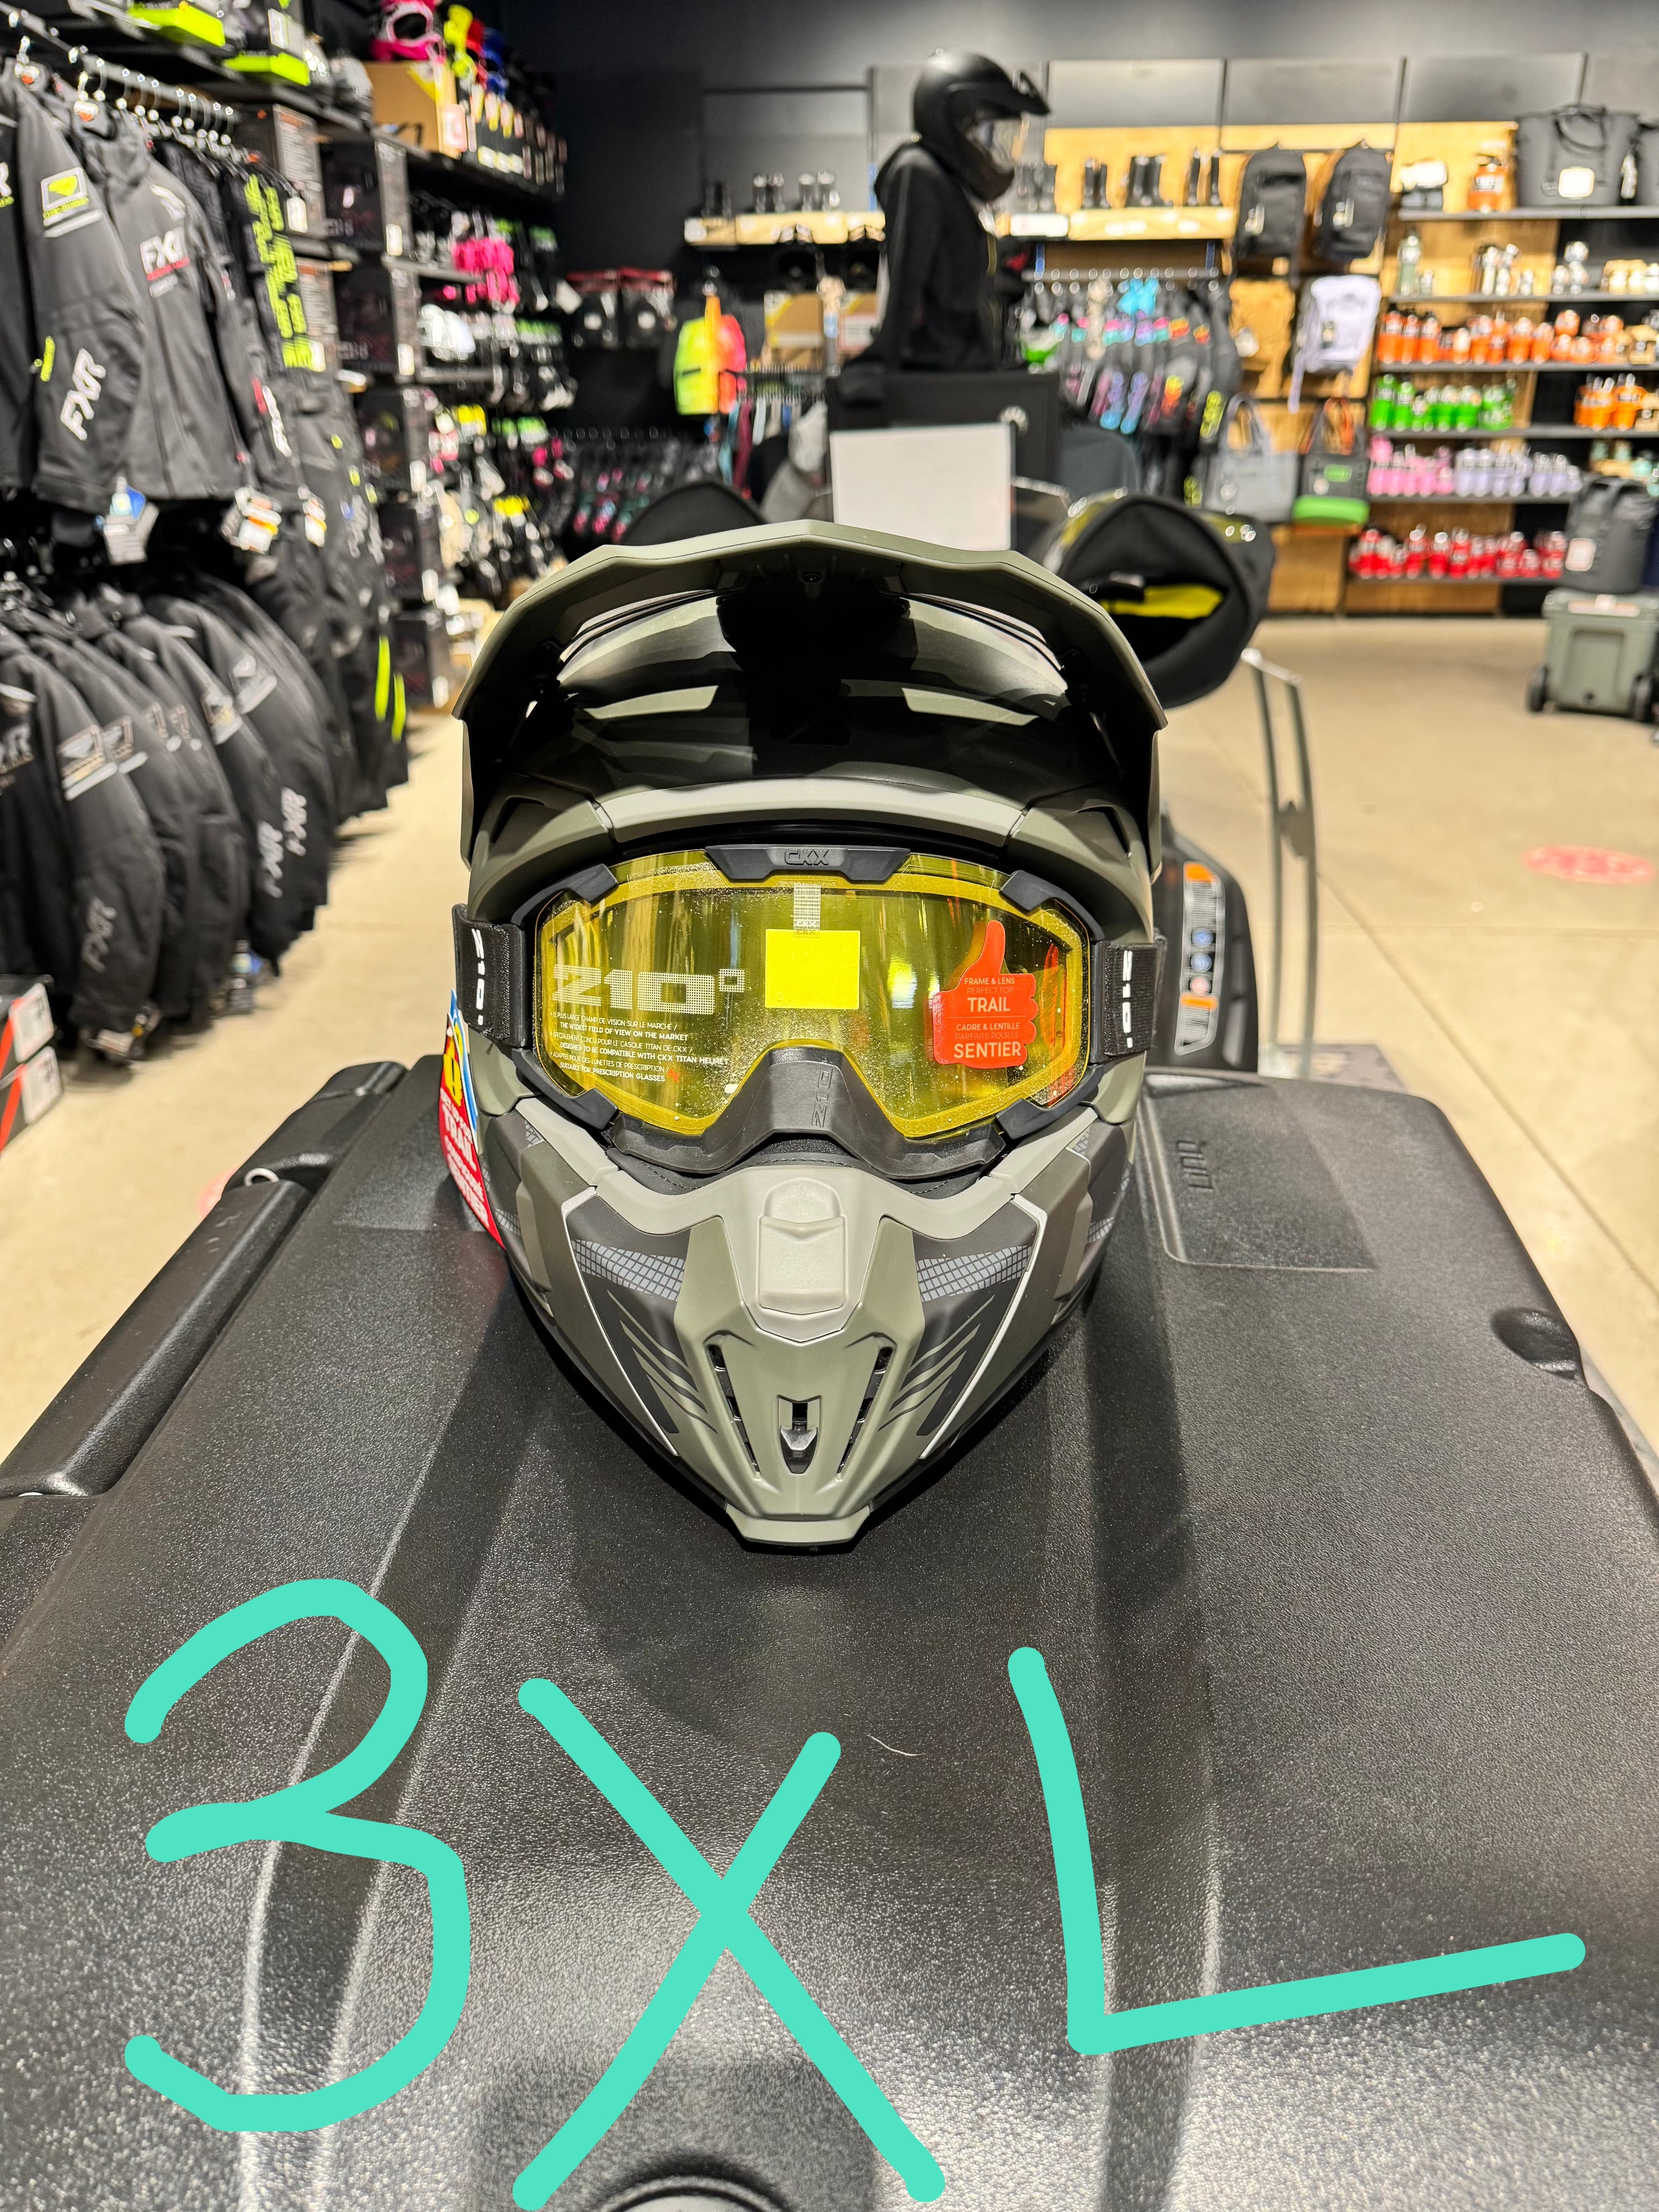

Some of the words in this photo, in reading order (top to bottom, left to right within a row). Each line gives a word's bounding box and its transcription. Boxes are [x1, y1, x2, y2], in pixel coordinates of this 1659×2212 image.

[784, 848, 829, 866] CKX
[967, 996, 1011, 1013] TRAIL
[557, 1012, 567, 1020] PLUS
[581, 1015, 598, 1023] CHAMP
[607, 1018, 625, 1027] VISION
[647, 1022, 672, 1030] MARCHÉ
[569, 1023, 588, 1032] WIDEST
[588, 1025, 604, 1034] FIELD
[615, 1028, 631, 1036] VIEW
[659, 1033, 689, 1041] MARKET
[560, 1041, 582, 1051] DESIGNED
[599, 1048, 636, 1058] COMPATIBLE
[637, 1052, 656, 1060] WITH
[657, 1054, 673, 1062] CKX
[699, 1057, 729, 1065] HELMET
[620, 1041, 643, 1049] CASQUE
[644, 1043, 661, 1051] TITAN
[954, 1041, 1021, 1059] SENTIER
[560, 1061, 581, 1072] SUITABLE
[581, 1065, 591, 1073] FOR
[592, 1067, 634, 1079] PRESCRIPTION
[635, 1073, 666, 1082] GLASSES
[591, 1058, 615, 1067] LUNETTES
[624, 1062, 665, 1073] PRESCRIPTION
[442, 1103, 477, 1172] TRAIL
